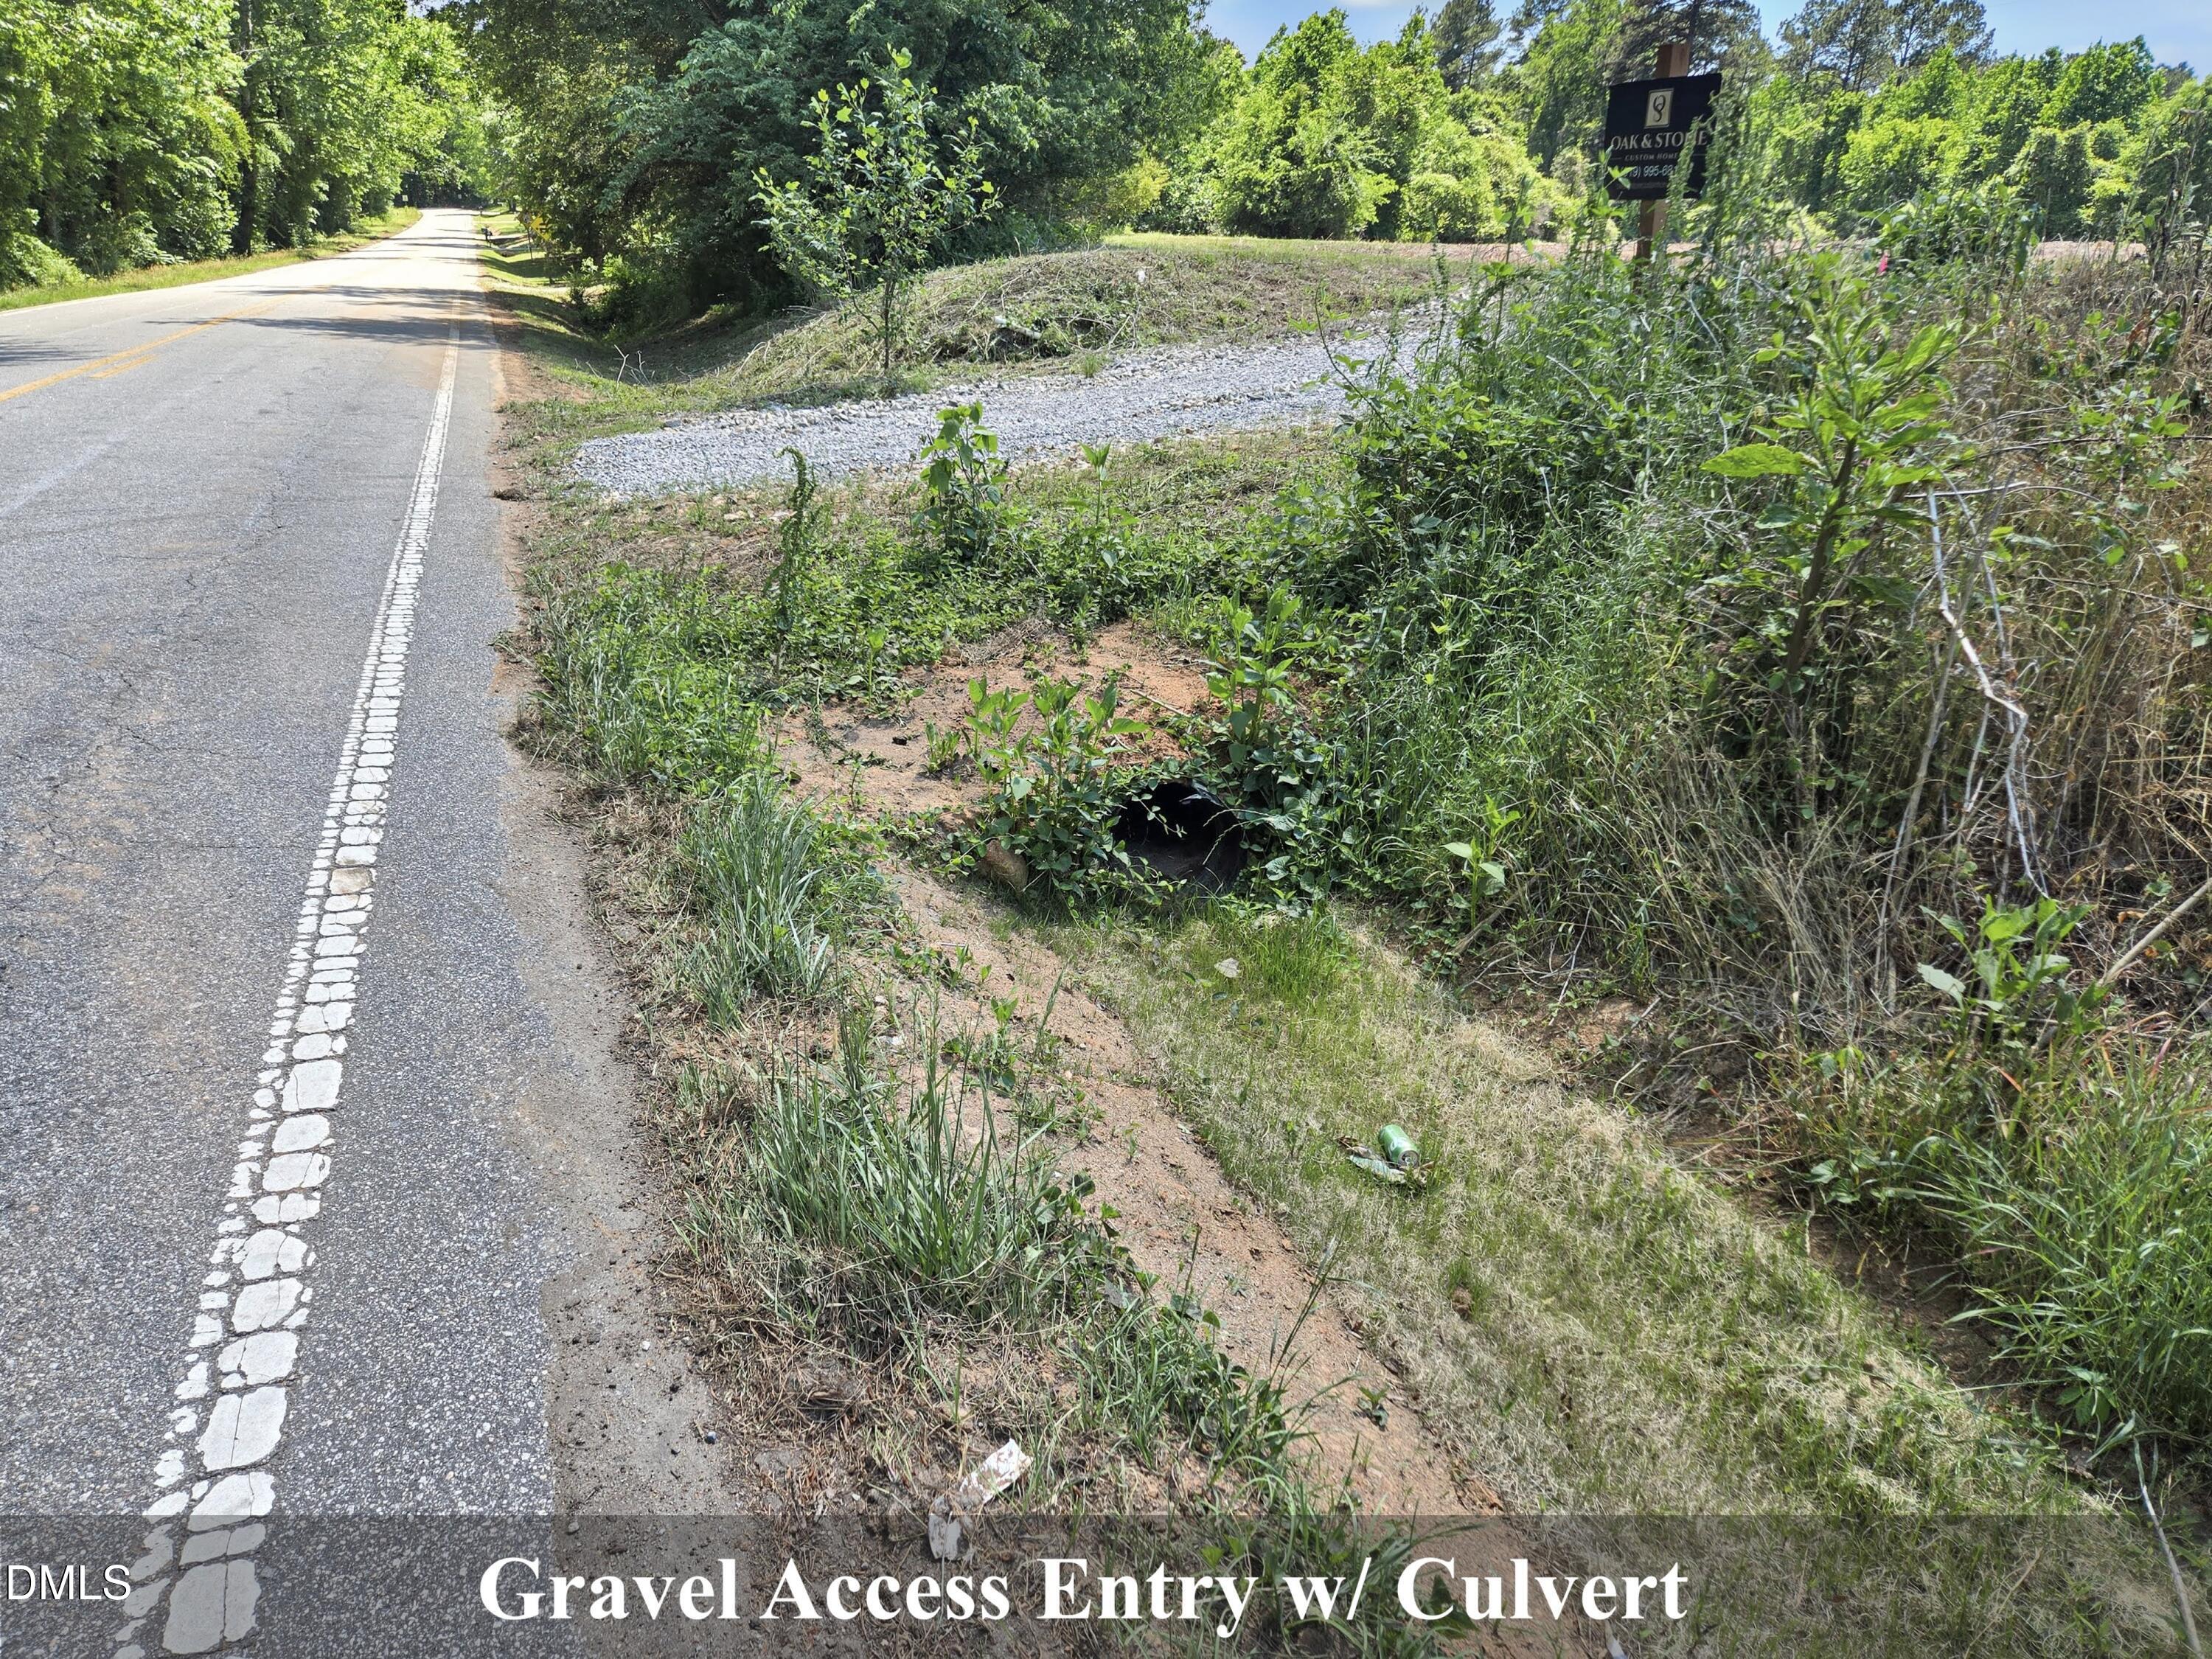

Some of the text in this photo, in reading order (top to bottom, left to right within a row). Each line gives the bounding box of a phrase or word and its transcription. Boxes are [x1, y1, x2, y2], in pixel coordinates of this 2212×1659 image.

[1610, 131, 1708, 150] OAK & STOE
[1624, 153, 1655, 161] CUSTOM
